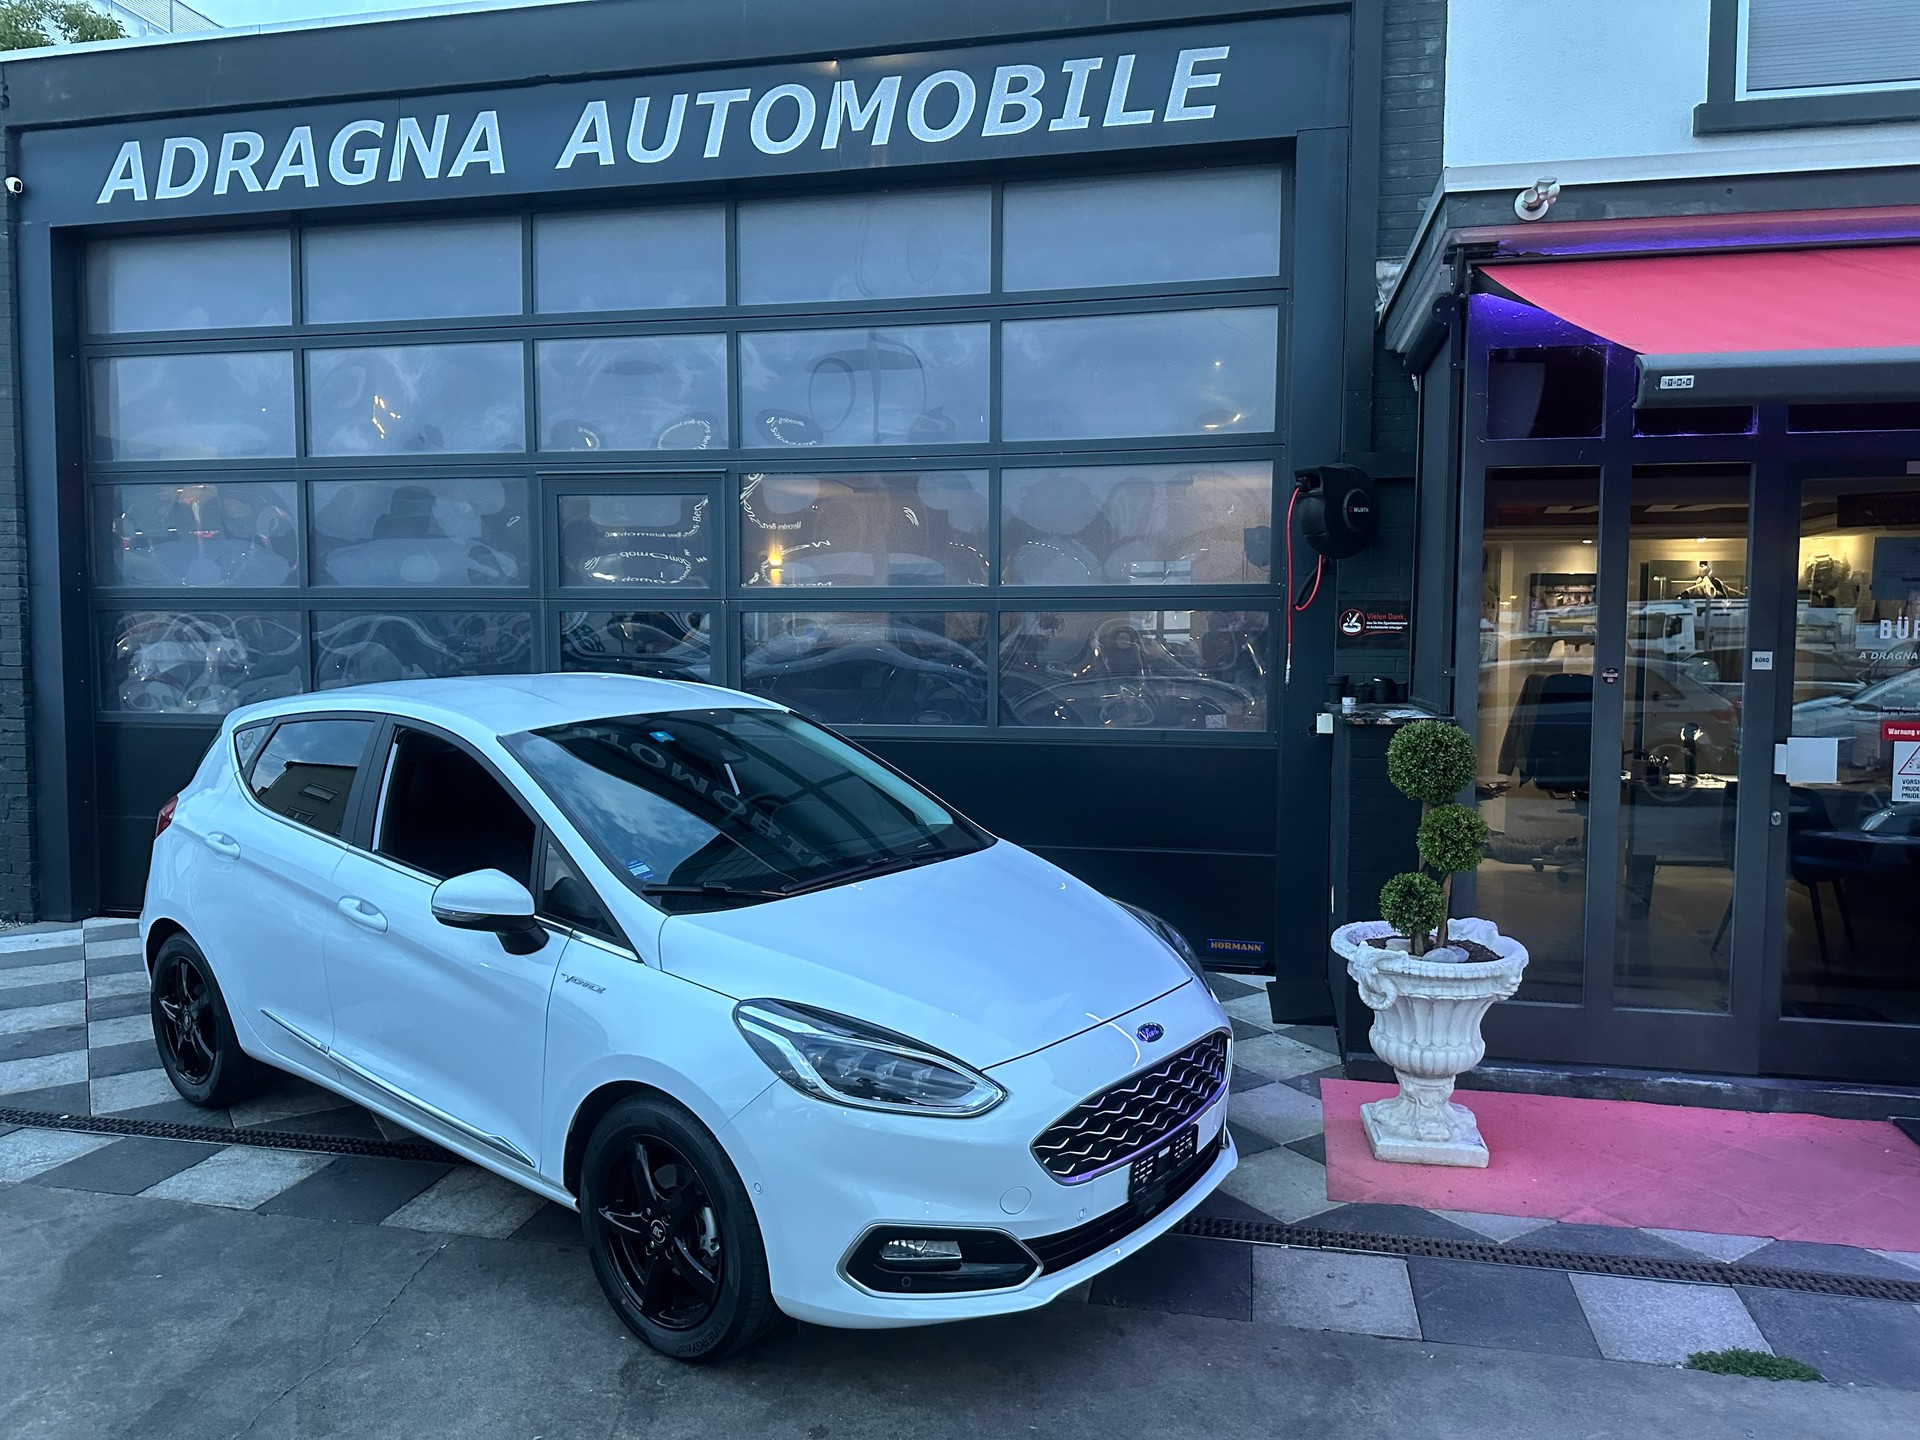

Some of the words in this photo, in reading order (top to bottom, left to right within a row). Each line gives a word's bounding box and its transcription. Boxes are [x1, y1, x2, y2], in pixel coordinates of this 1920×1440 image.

[96, 110, 505, 204] ADRAGNA
[555, 45, 1230, 169] AUTOMOBILE
[1887, 728, 1915, 737] Warnung
